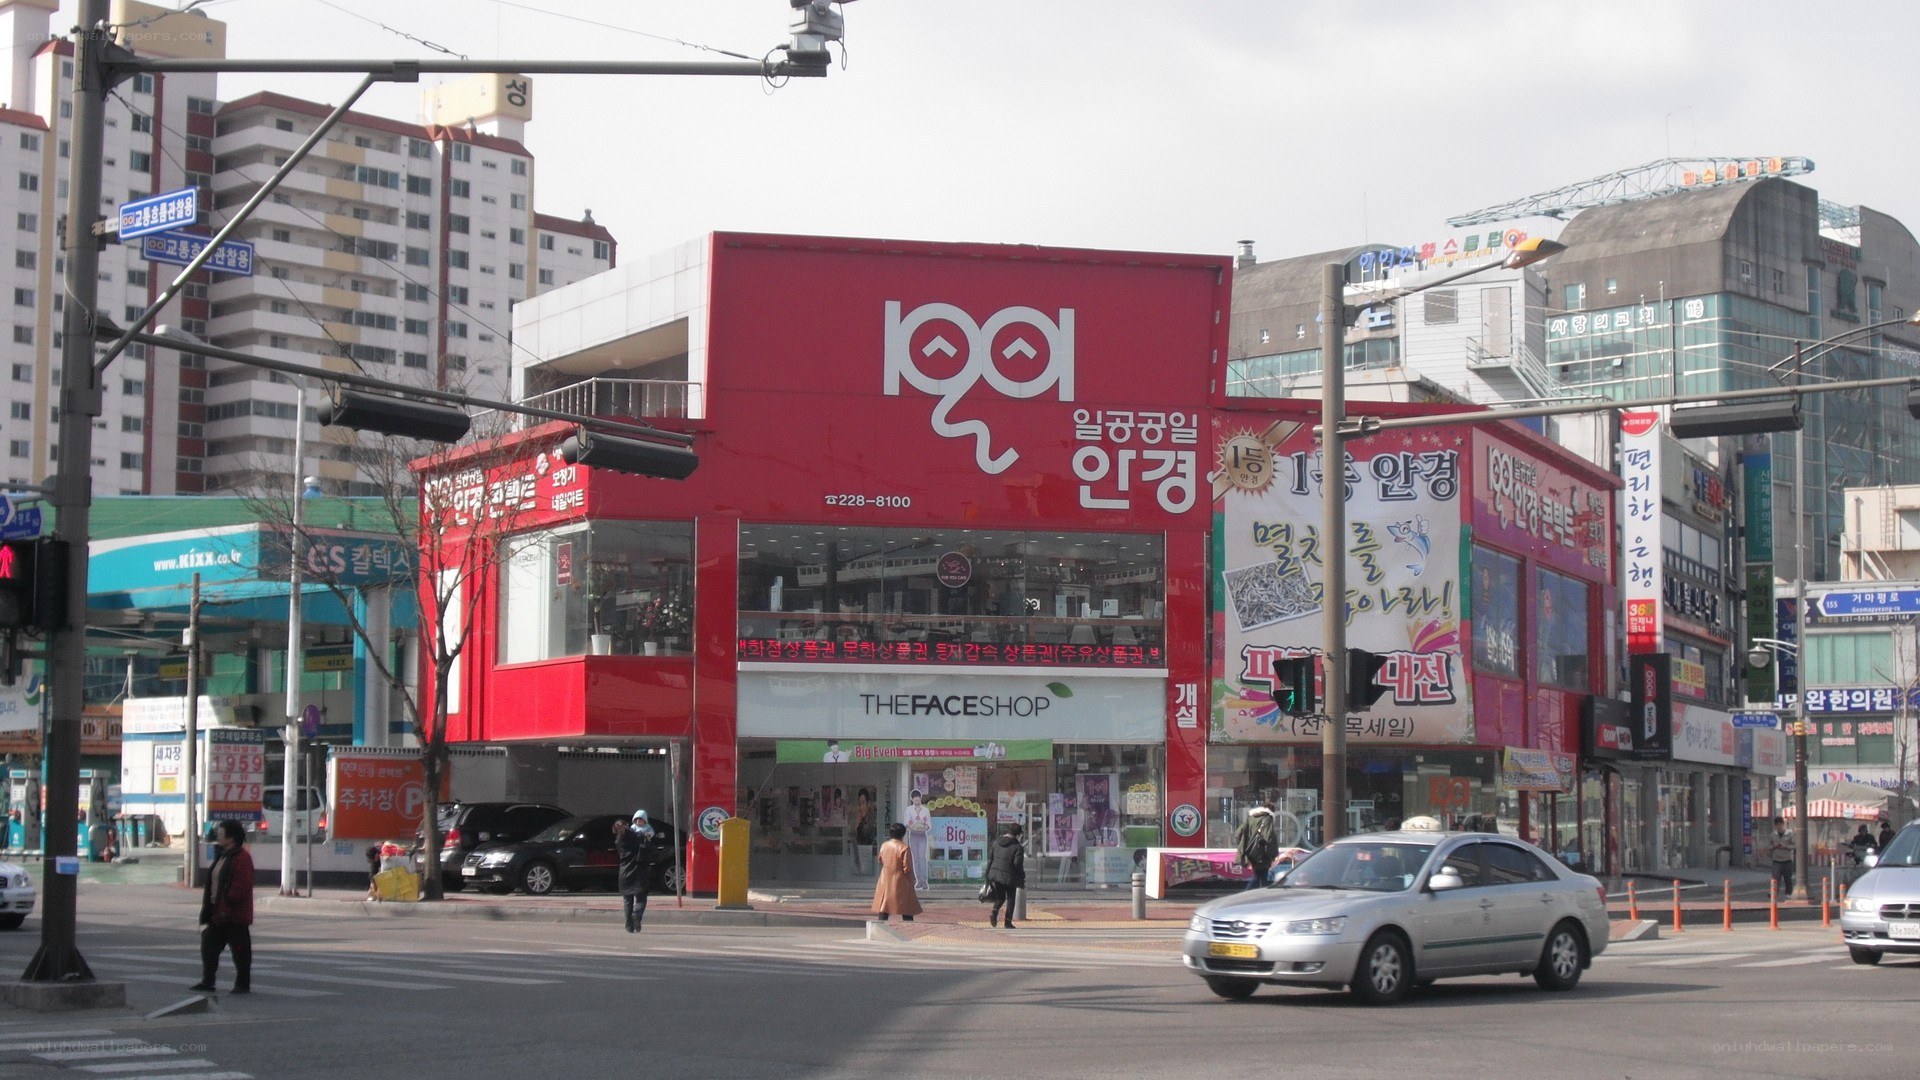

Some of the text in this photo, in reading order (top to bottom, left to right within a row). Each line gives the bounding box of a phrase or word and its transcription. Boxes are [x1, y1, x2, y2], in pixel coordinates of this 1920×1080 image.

[505, 79, 527, 107] 성
[134, 196, 193, 227] 교통흐름관찰용
[165, 238, 249, 269] 교통흐관찰용
[1073, 408, 1198, 444] 일공공일
[1232, 445, 1265, 474] 1등
[1072, 445, 1196, 514] 안경
[1240, 473, 1260, 484] 안경
[1368, 449, 1459, 501] 안경
[552, 489, 585, 511] 네일아트
[839, 494, 911, 508] 228-8100
[1512, 482, 1538, 536] 안경
[1625, 448, 1655, 588] 편리한 은행
[308, 545, 346, 574] GS
[1629, 603, 1655, 616] 365
[1826, 601, 1839, 609] 155
[1852, 592, 1900, 605] 거마평로
[1175, 683, 1198, 729] 개설
[1291, 716, 1415, 738] (전목세일)
[155, 746, 181, 761] 세차장
[213, 755, 263, 772] 1959
[855, 745, 899, 759] Big Event
[209, 783, 262, 801] 1779
[340, 787, 424, 814] 주차장 P
[1171, 859, 1212, 877] 1주년
